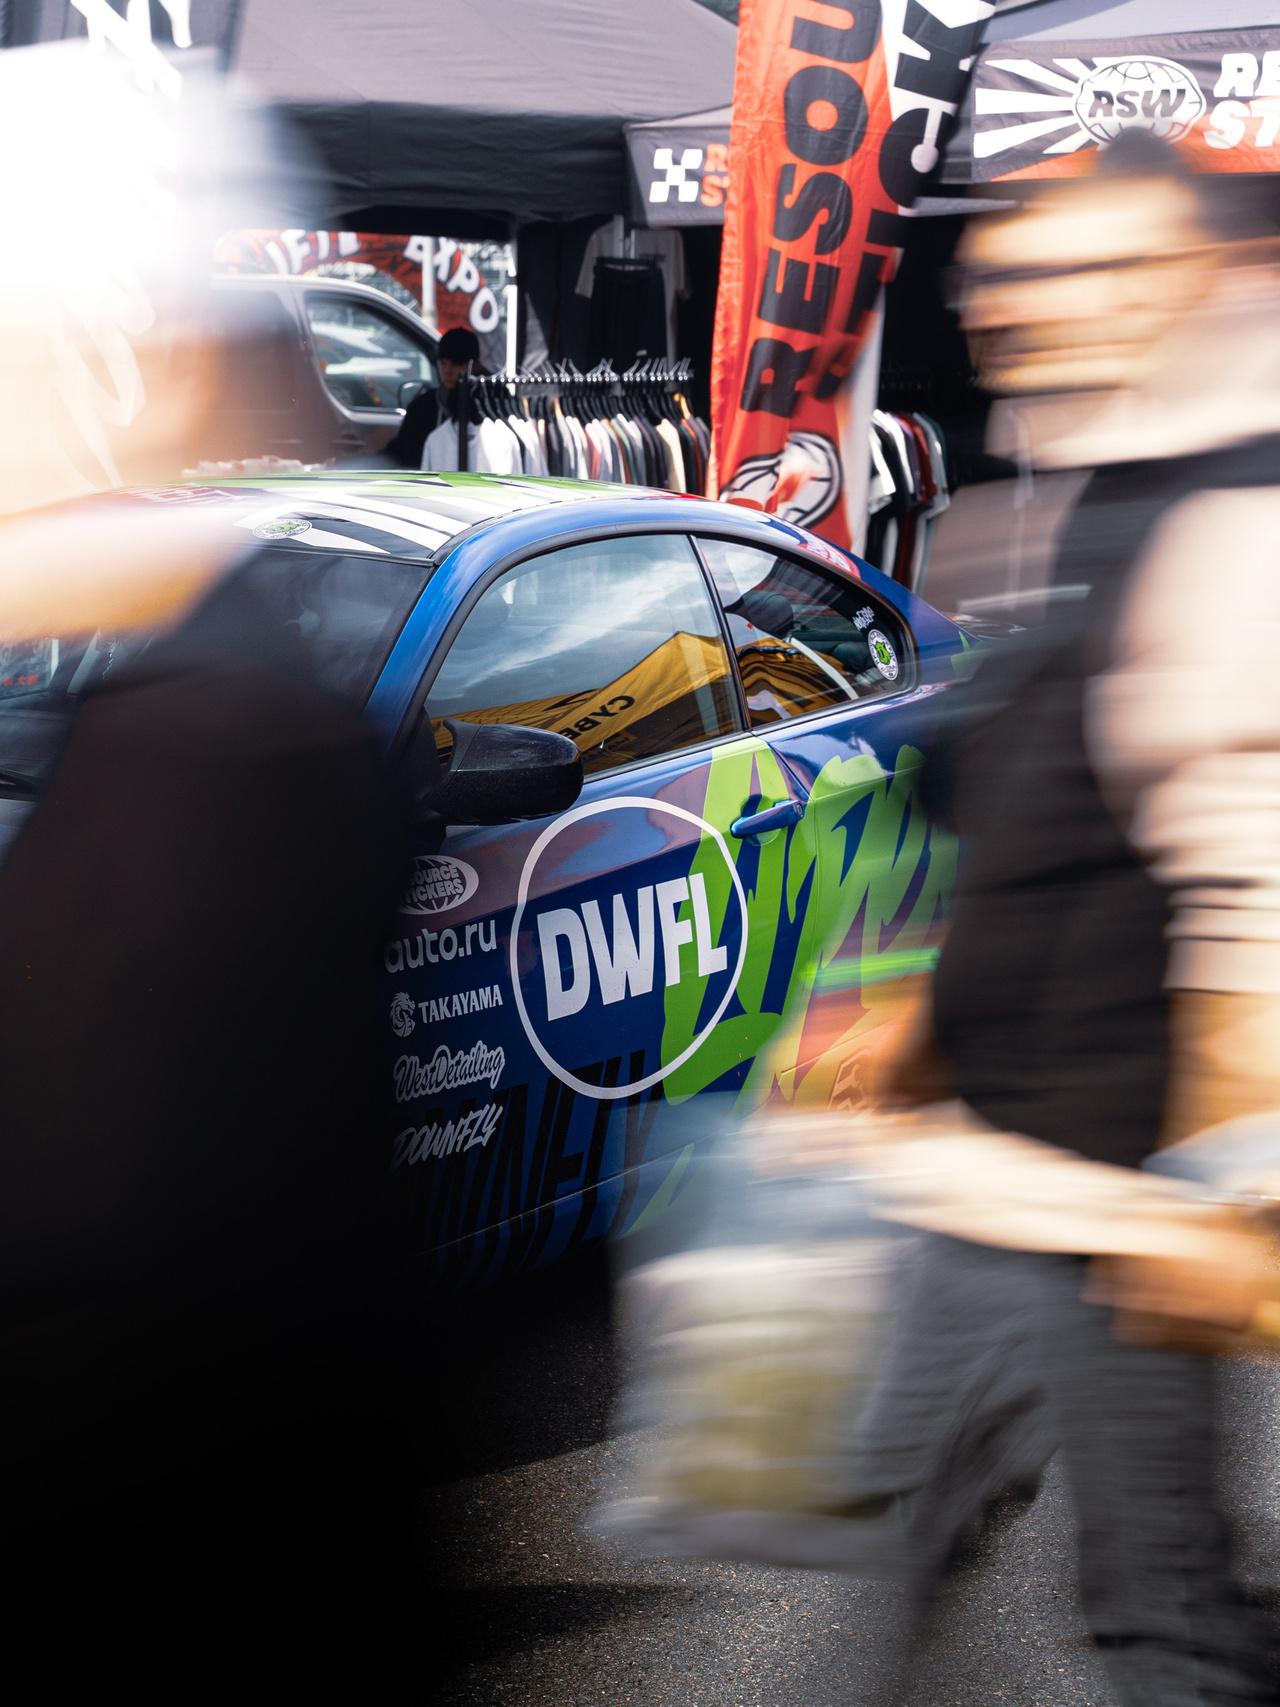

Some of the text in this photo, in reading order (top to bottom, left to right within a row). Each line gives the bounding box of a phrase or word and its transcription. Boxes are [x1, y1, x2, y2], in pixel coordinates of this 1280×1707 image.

[1088, 89, 1186, 118] RSW
[384, 920, 497, 973] auto.ru
[537, 872, 727, 1021] DWFL
[419, 984, 504, 1024] TAKAYAMA
